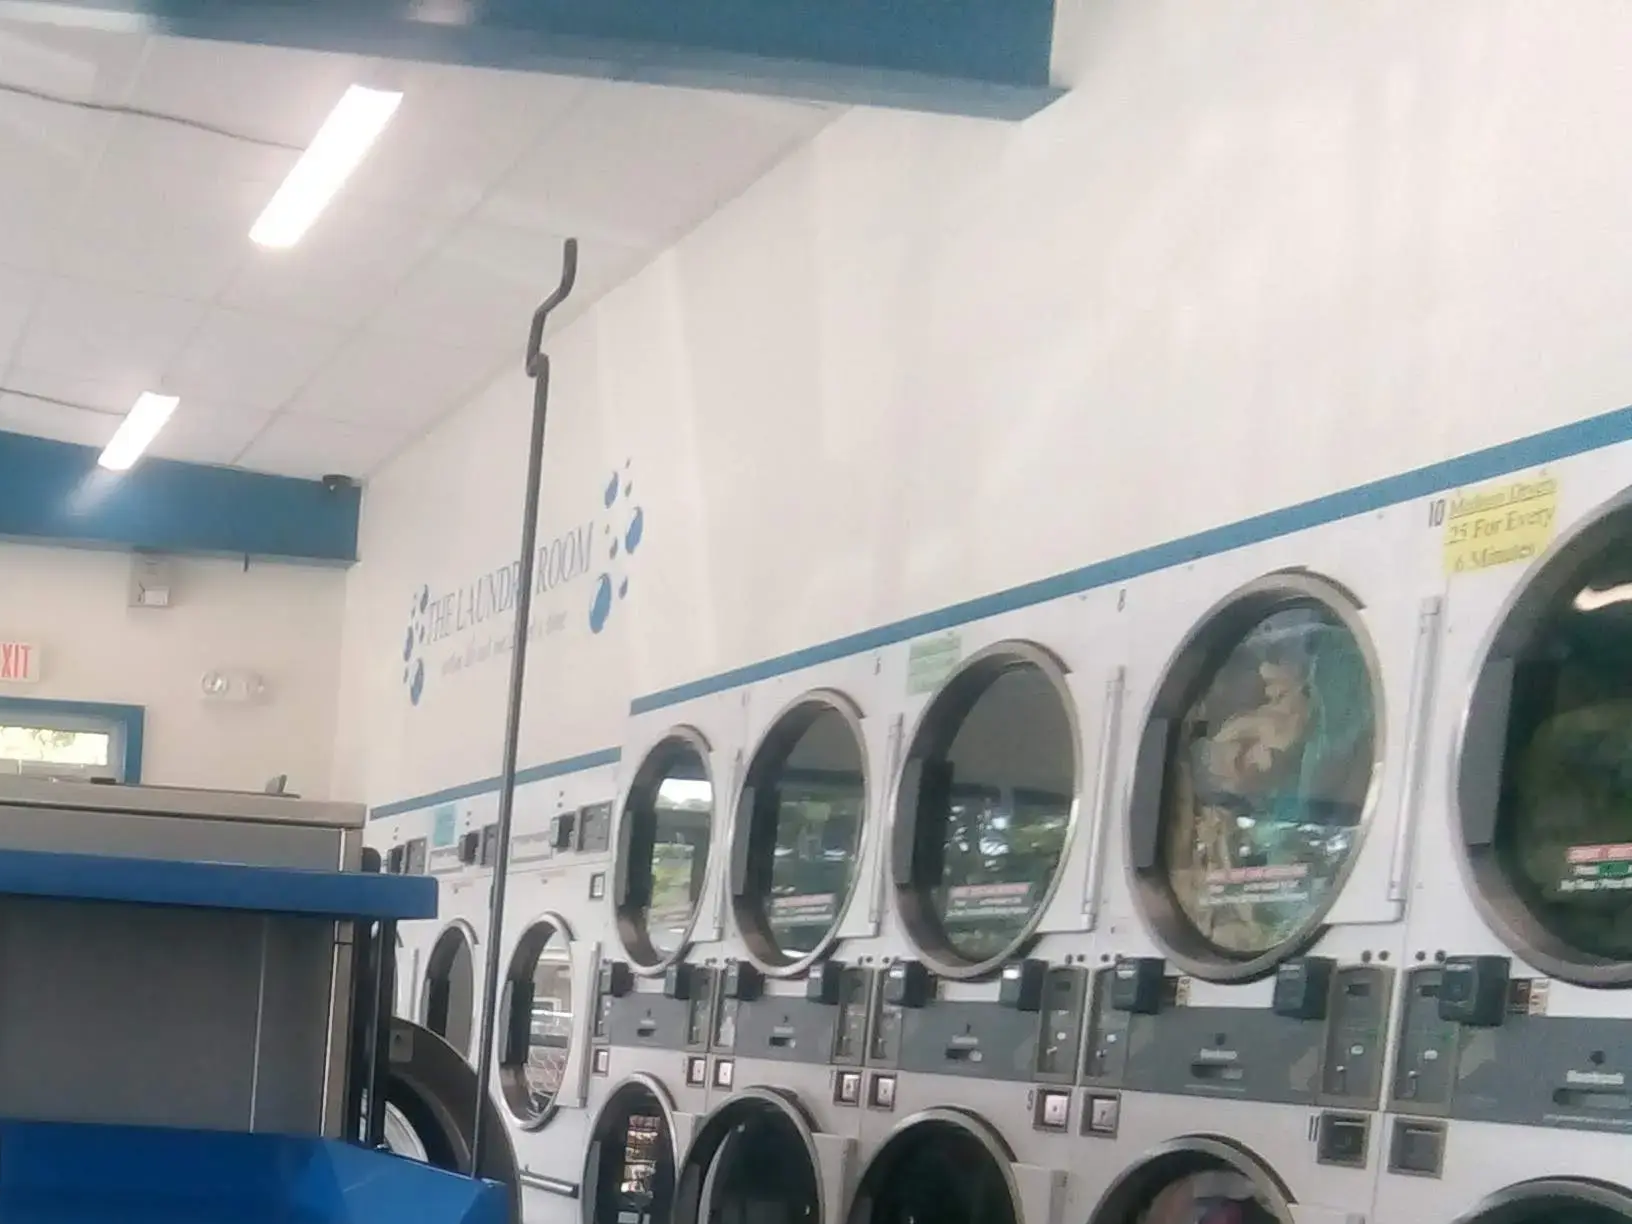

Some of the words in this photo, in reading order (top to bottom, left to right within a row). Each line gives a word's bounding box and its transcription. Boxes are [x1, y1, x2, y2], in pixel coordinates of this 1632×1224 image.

[1429, 499, 1445, 528] 10
[457, 559, 526, 632] LAUNDR
[535, 520, 594, 595] ROOM
